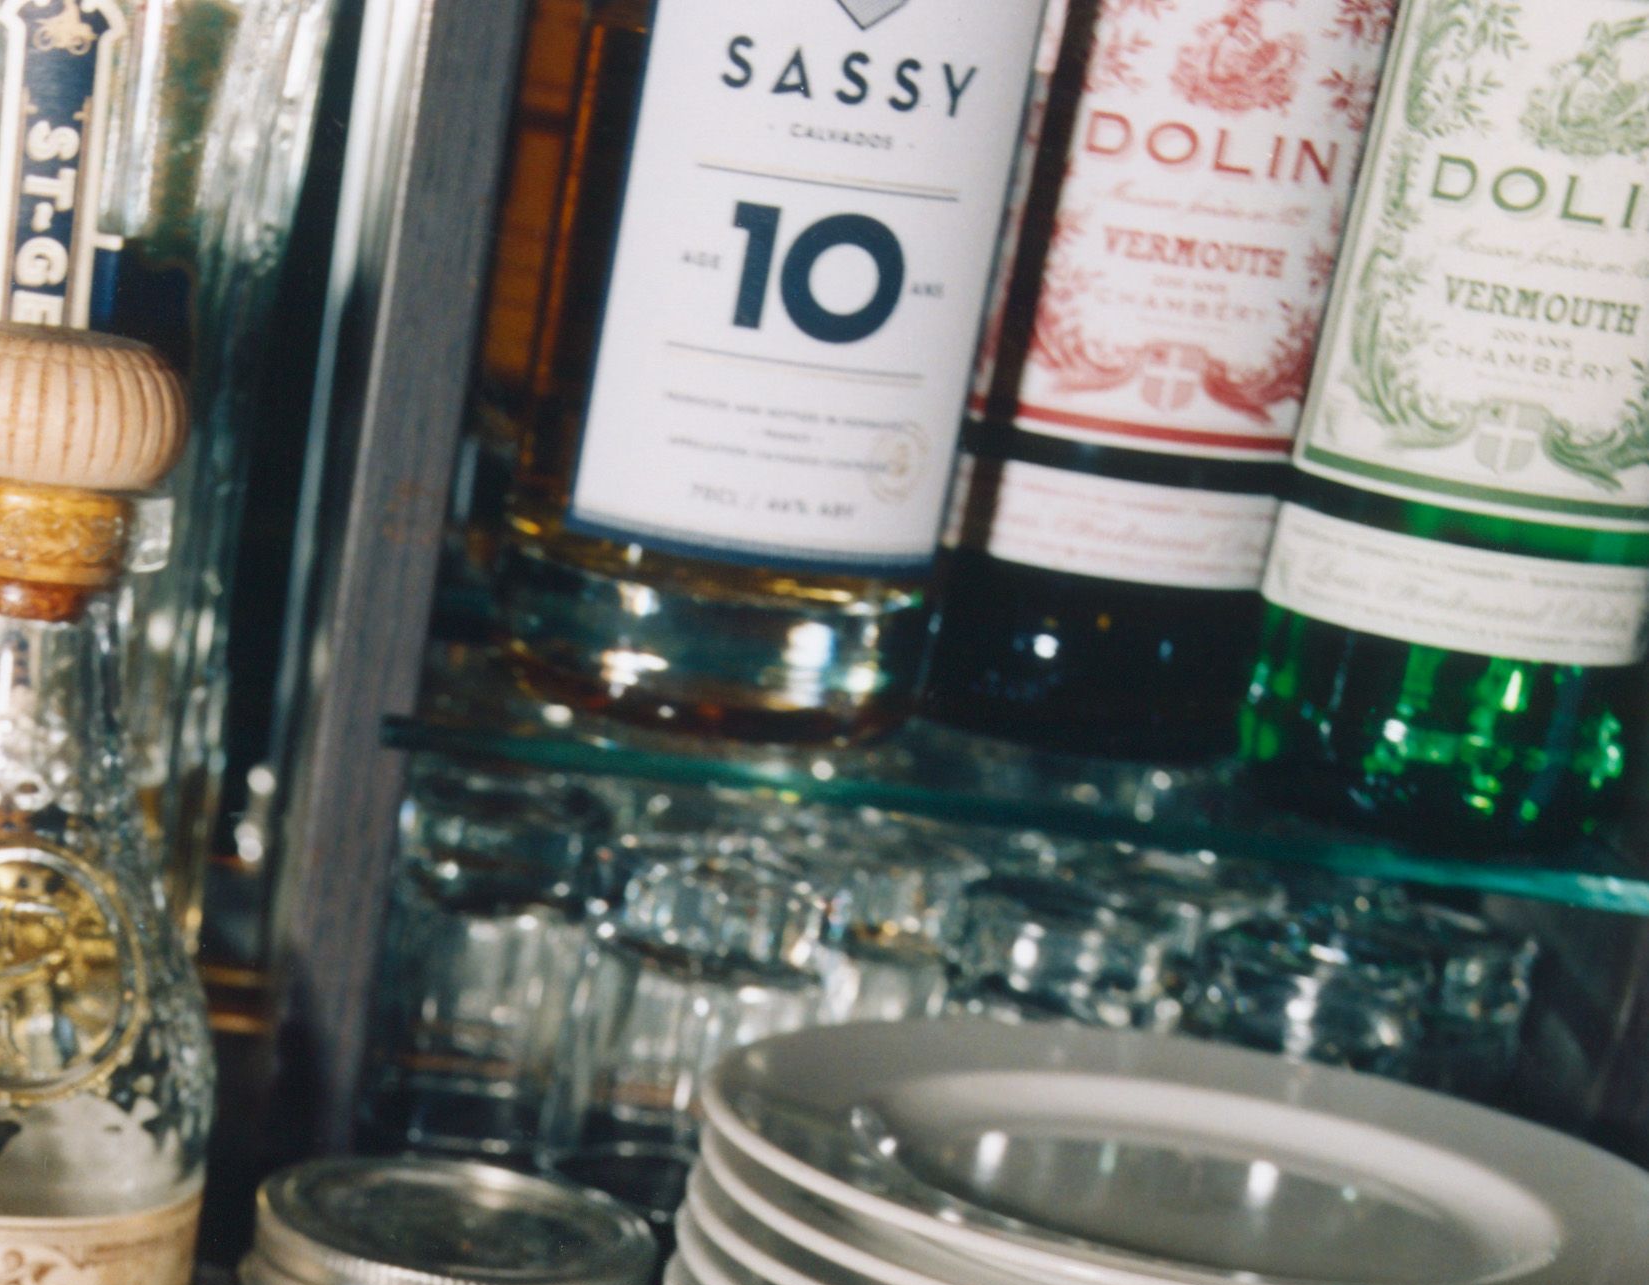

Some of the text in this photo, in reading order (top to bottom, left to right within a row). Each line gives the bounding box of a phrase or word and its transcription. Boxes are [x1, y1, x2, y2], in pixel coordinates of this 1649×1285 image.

[721, 34, 977, 118] SASSY
[789, 122, 895, 151] CALVADOS
[1085, 110, 1339, 185] DOLIN
[1430, 153, 1649, 231] DOLI
[731, 200, 905, 345] 10
[1103, 225, 1288, 278] VERMOUTH
[1445, 274, 1642, 336] VERMOUTH
